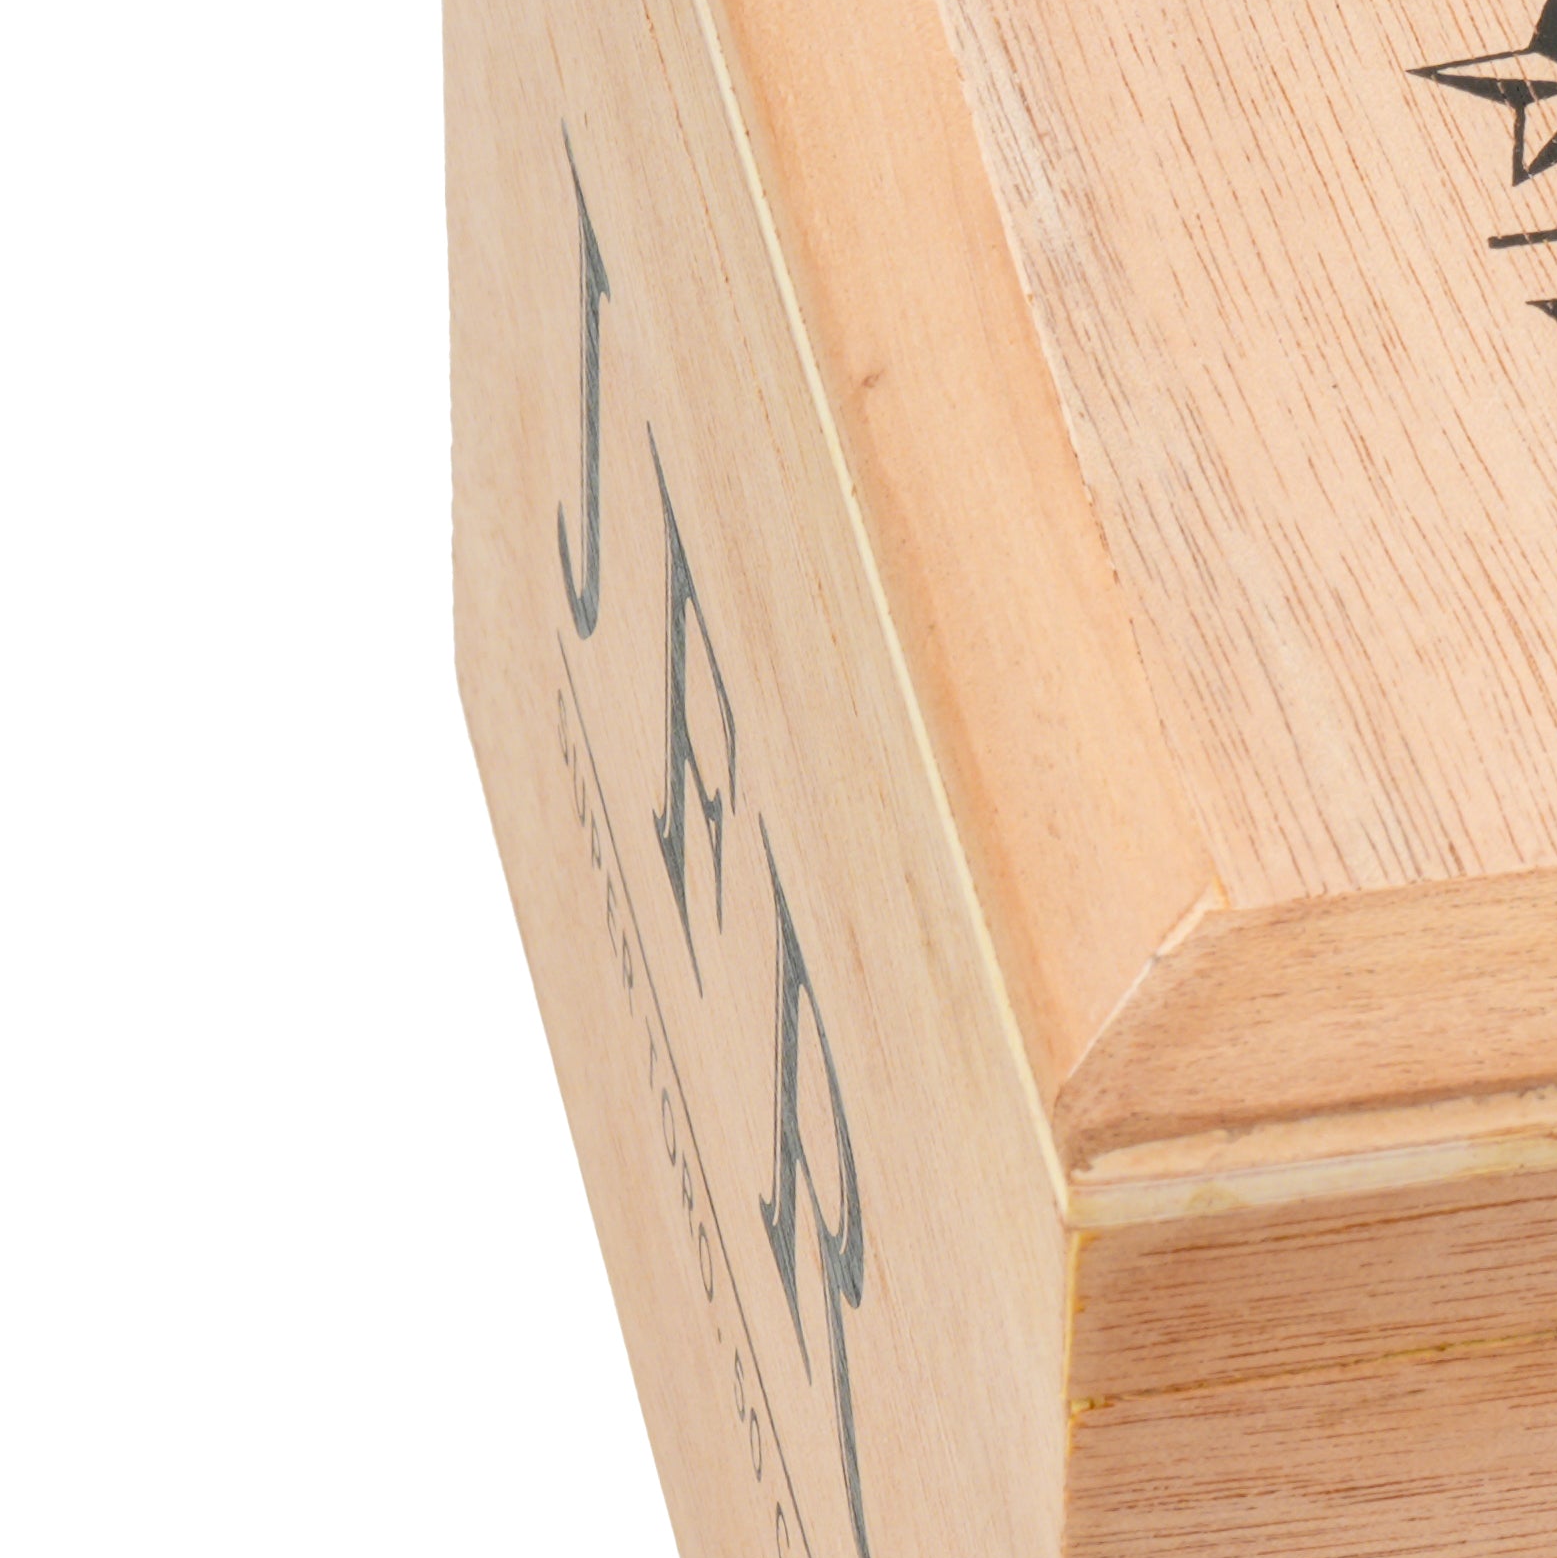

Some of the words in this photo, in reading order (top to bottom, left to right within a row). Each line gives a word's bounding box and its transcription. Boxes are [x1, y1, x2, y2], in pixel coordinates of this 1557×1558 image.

[557, 688, 634, 1018] SUPER
[645, 1016, 714, 1304] TORO
[734, 1347, 762, 1483] 50
